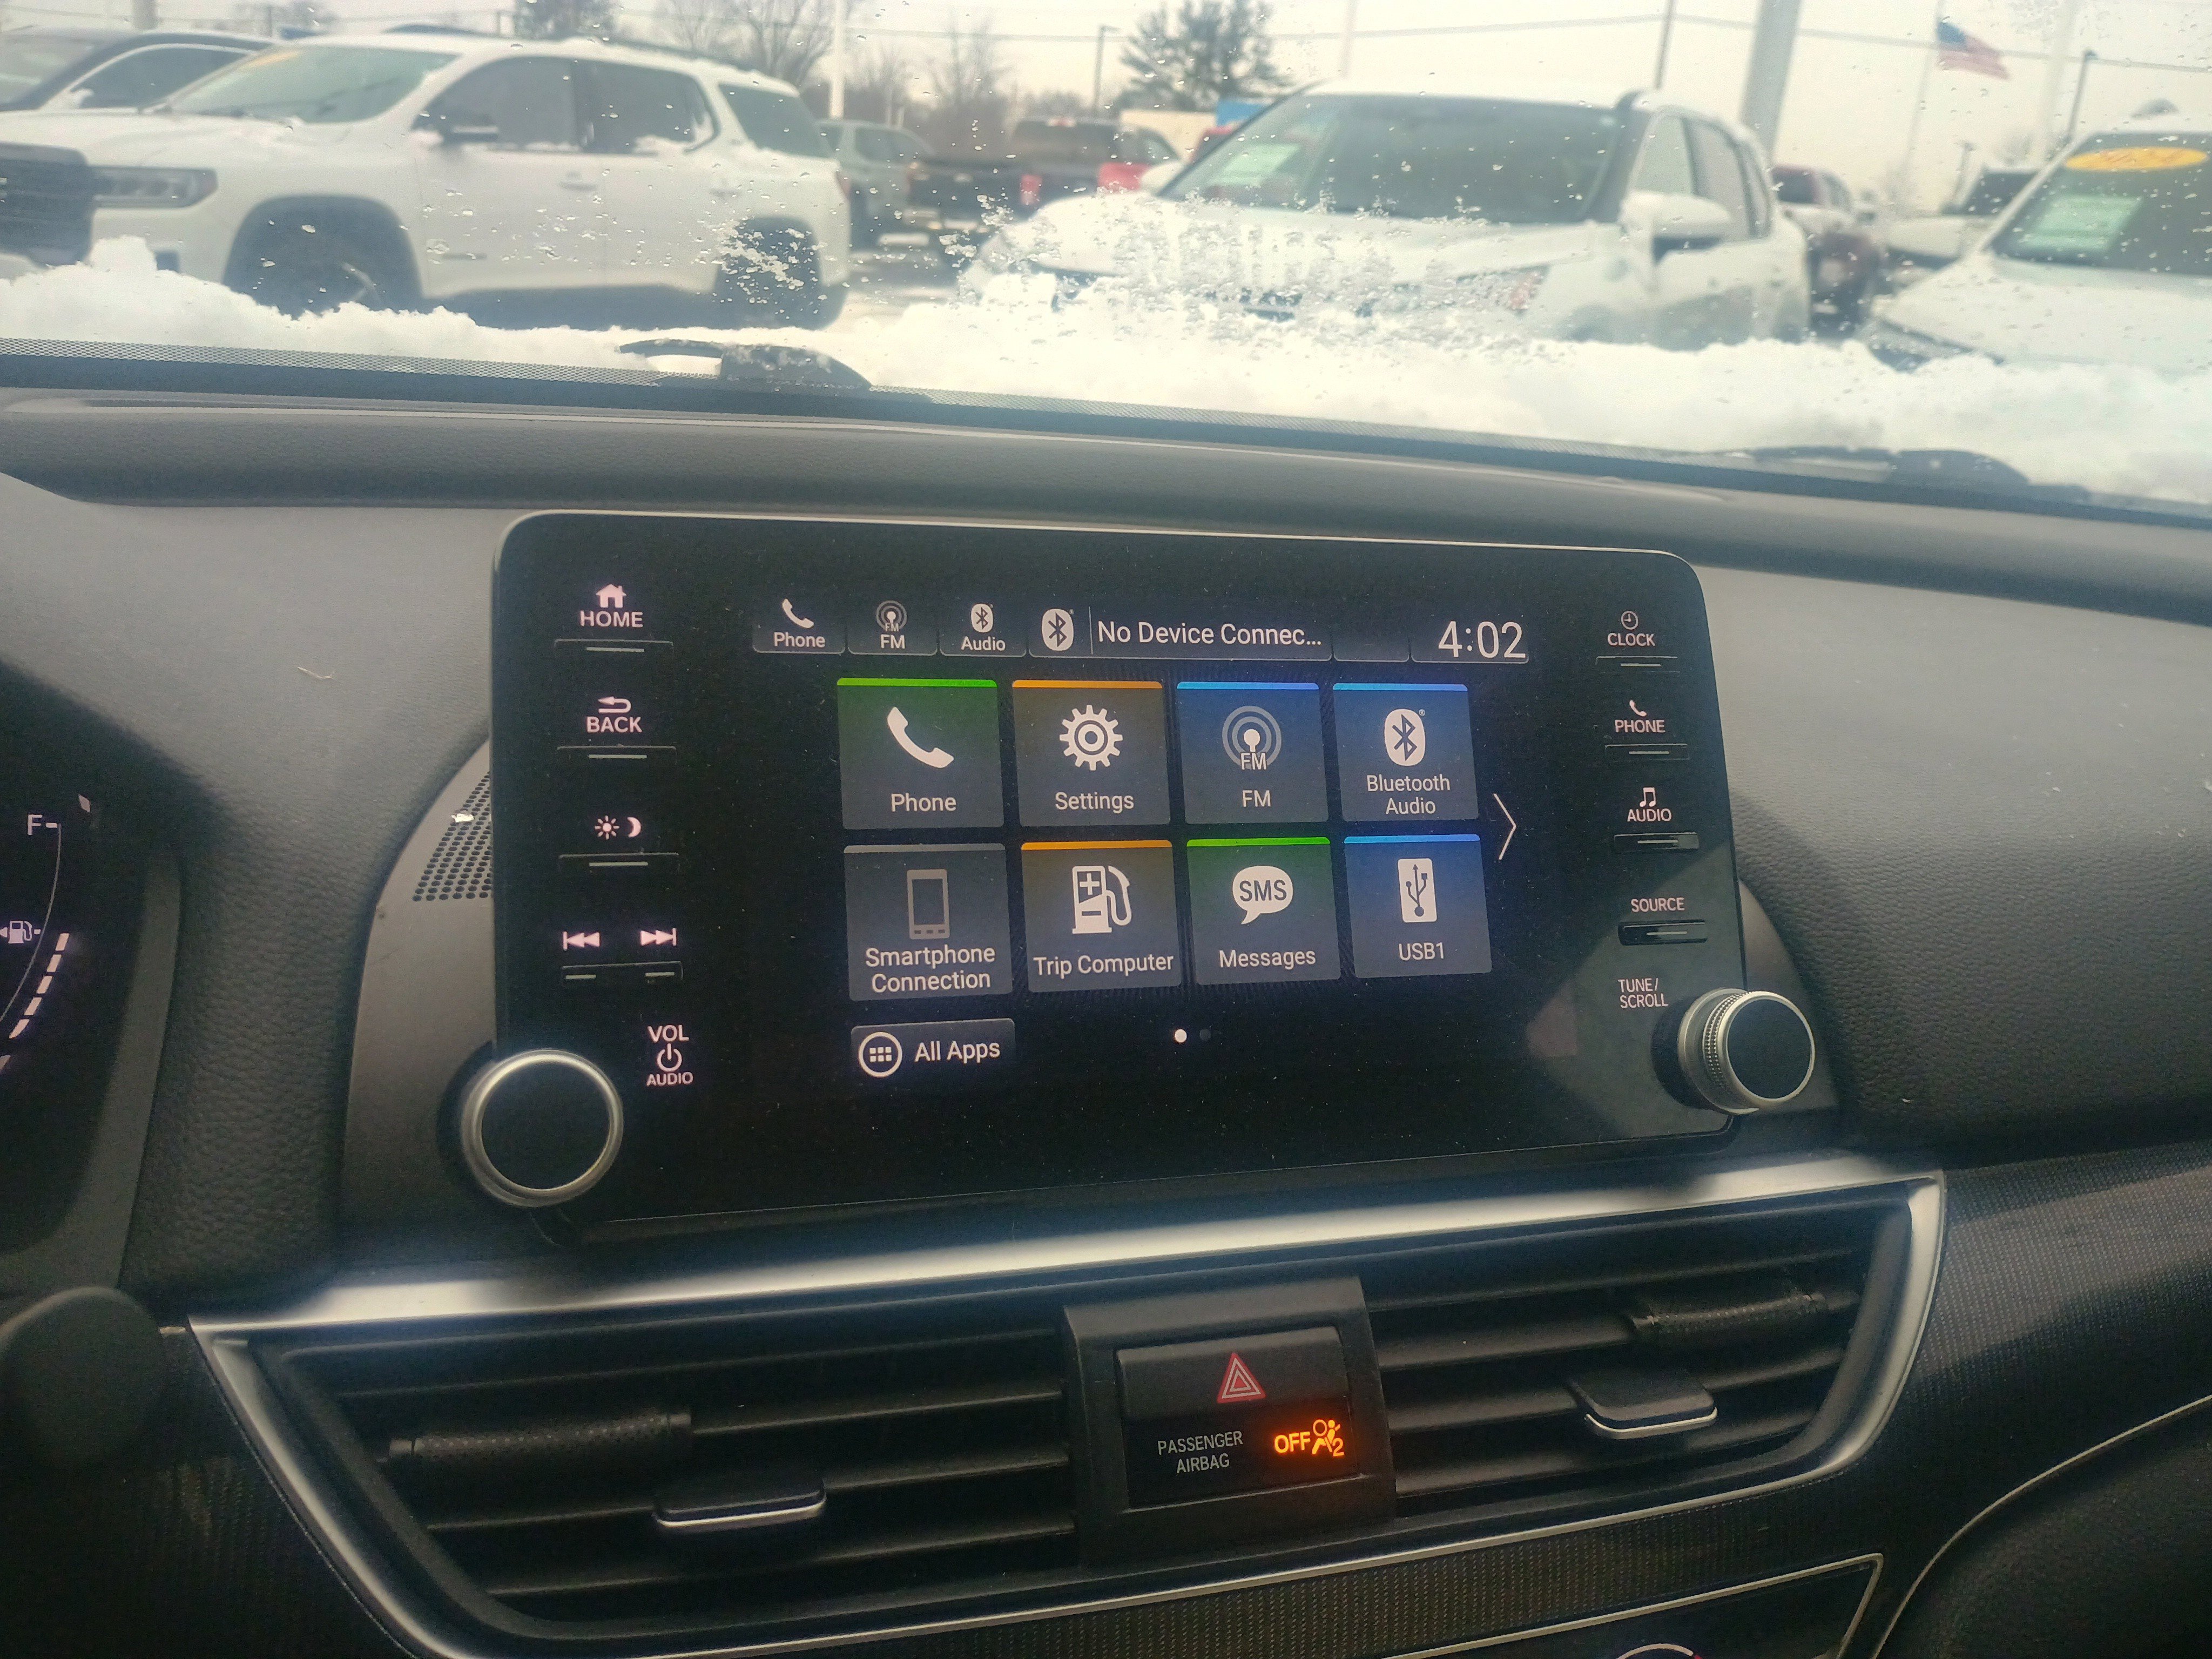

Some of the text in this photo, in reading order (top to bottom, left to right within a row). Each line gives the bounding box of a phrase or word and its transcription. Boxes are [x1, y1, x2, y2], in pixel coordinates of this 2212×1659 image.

[579, 611, 644, 628] HOME
[885, 623, 900, 632] FM
[774, 632, 825, 648] Phone
[880, 635, 905, 649] FM
[1098, 621, 1321, 646] No Device Connec...
[1438, 621, 1526, 658] 4:02
[1608, 633, 1655, 646] CLOCK
[961, 637, 1006, 651] Audio
[586, 717, 642, 733] BACK
[1615, 719, 1665, 733] PHONE
[1240, 753, 1267, 770] FM
[1367, 774, 1451, 792] Bluetooth
[891, 793, 956, 811] Phone
[1055, 791, 1134, 813] Settings
[1243, 790, 1271, 807] FM
[1386, 797, 1436, 815] Audio
[1627, 808, 1672, 822] AUDIO
[28, 814, 43, 835] F
[1239, 879, 1287, 902] SMS
[1631, 897, 1685, 913] SOURCE
[866, 945, 995, 969] Smartphone
[1219, 949, 1316, 970] Messages
[1399, 942, 1444, 960] USB1
[1034, 953, 1174, 979] Trip Computer
[872, 970, 991, 994] Connection
[1618, 977, 1658, 993] TUNE/
[1620, 994, 1668, 1008] SCROLL
[648, 1025, 689, 1042] VOL
[915, 1041, 1001, 1064] All Apps
[647, 1072, 693, 1086] AUDIO
[1157, 1431, 1243, 1455] PASSENGER
[1274, 1431, 1311, 1454] OFF
[1176, 1453, 1230, 1474] AIRBAG
